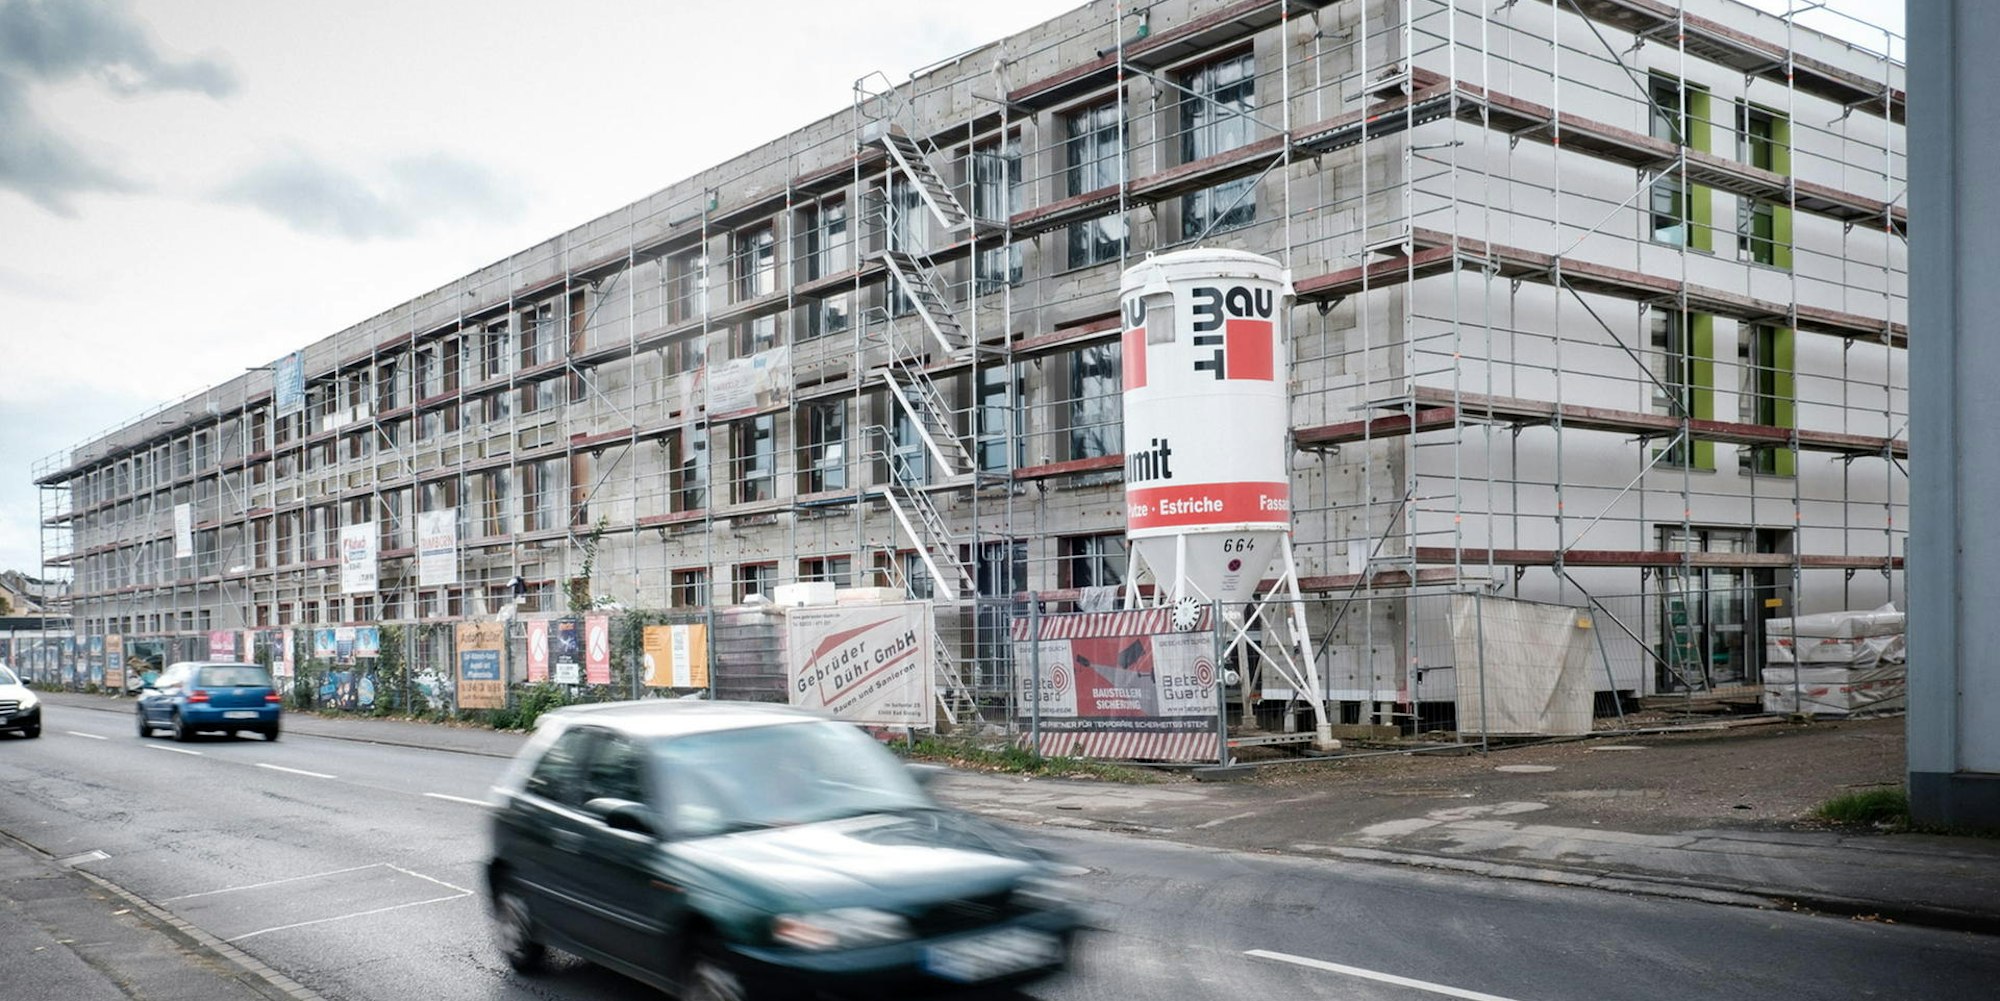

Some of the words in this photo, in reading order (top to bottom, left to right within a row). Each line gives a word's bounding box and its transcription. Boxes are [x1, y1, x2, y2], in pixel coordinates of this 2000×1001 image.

[1160, 496, 1223, 515] Estriche
[1224, 538, 1254, 552] 664
[798, 641, 866, 693] Gebrüder
[834, 660, 869, 690] Dühr
[875, 630, 917, 664] GmbH
[1023, 678, 1053, 690] Bta
[1162, 673, 1198, 687] Beta
[833, 696, 857, 715] Bauen
[858, 686, 875, 699] und
[875, 662, 916, 689] Sanieren
[1092, 688, 1142, 699] BAUSTELLEN
[1164, 687, 1209, 700] Guard
